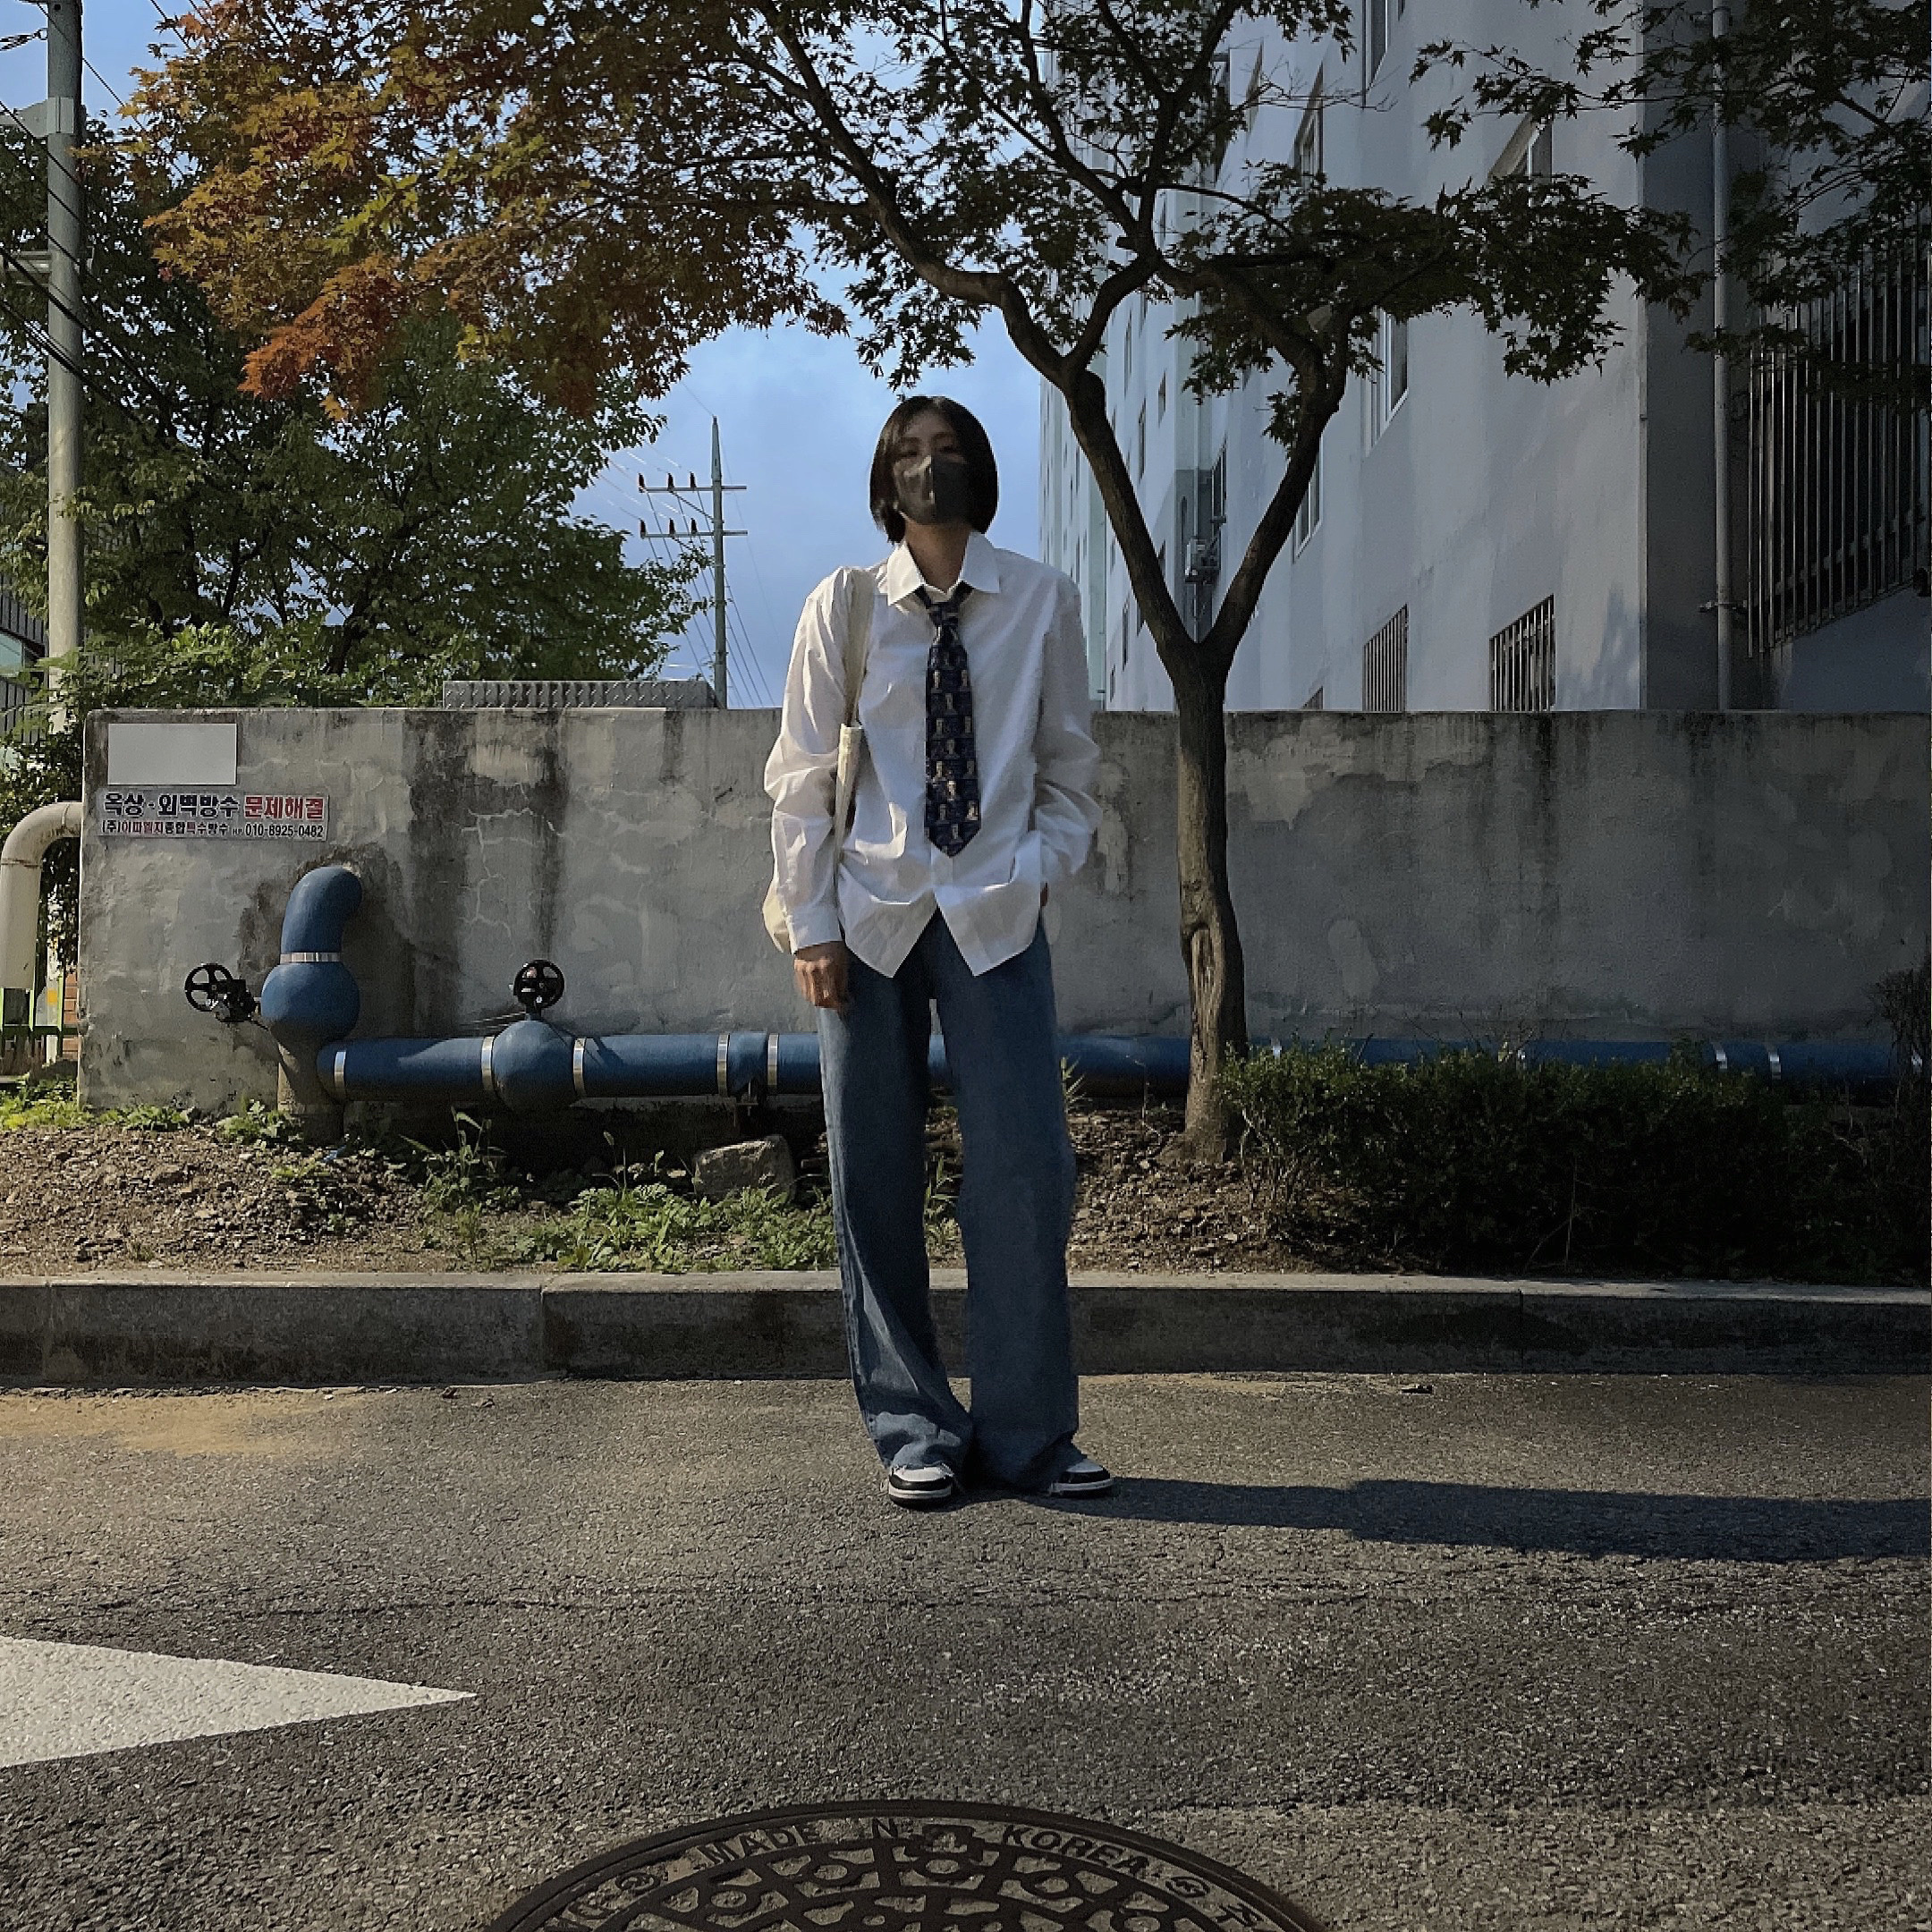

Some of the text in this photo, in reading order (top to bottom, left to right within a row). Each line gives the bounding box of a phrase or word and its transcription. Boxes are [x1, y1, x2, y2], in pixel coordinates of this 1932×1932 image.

[245, 794, 325, 820] 문제해결
[245, 823, 325, 837] 010-8925-0482
[1003, 1824, 1150, 1878] KOREA
